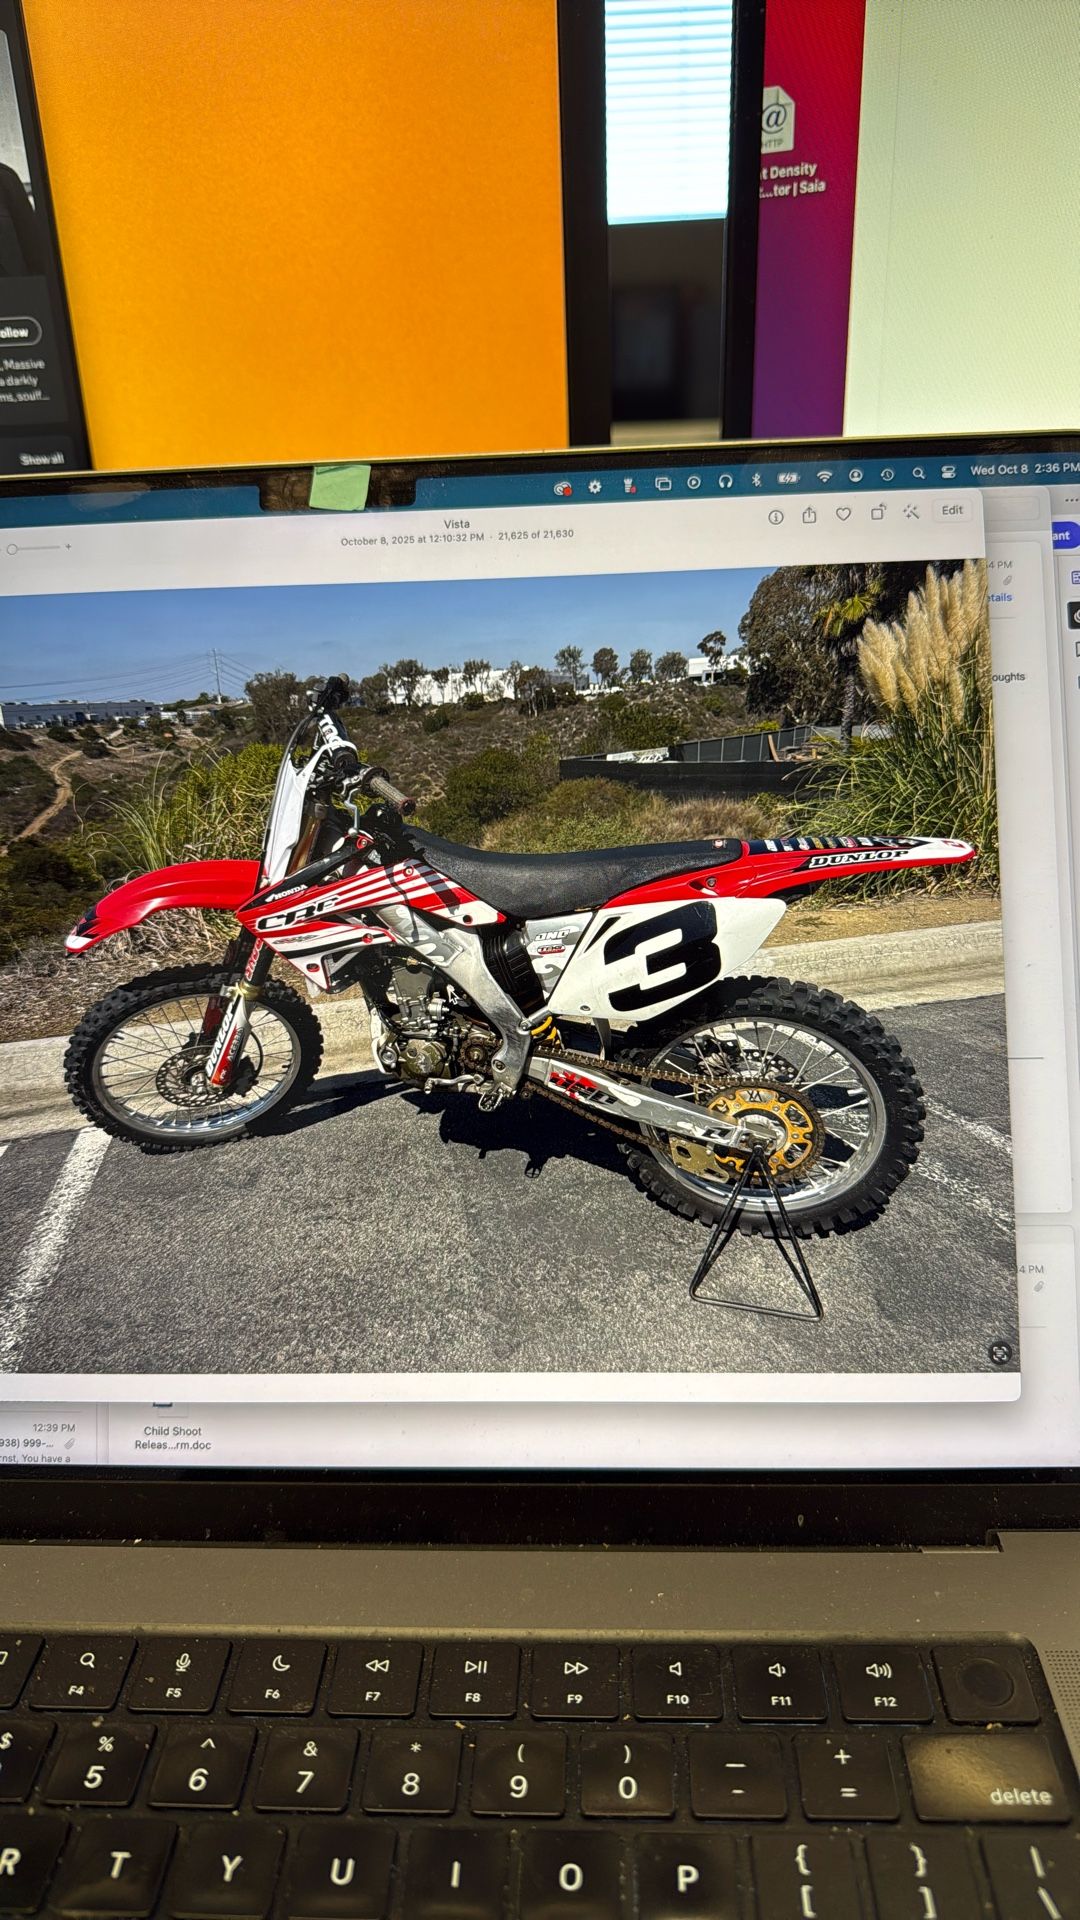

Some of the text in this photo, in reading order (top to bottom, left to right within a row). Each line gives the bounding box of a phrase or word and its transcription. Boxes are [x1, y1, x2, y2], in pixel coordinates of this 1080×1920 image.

[770, 162, 817, 179] Density
[799, 181, 826, 193] Saia
[3, 359, 45, 370] Massive
[6, 375, 38, 388] darkly
[19, 452, 64, 466] Show all
[970, 462, 1080, 476] Wed Oct 8 2:36 PM
[941, 505, 964, 516] Edit
[444, 519, 471, 529] Vista
[340, 529, 575, 547] October 8, 2025 at 12:10:32 PM 21,625 of 21,630
[997, 561, 1013, 569] PM
[992, 672, 1026, 684] oughts
[809, 850, 909, 868] DUNLOP
[273, 884, 309, 900] HONDA
[257, 896, 340, 931] CRF
[603, 901, 722, 1012] 3
[204, 1001, 234, 1079] DUNLOP
[1028, 1265, 1045, 1274] PM
[33, 1423, 76, 1433] 12:39 PM
[143, 1426, 202, 1436] Child Shoot
[135, 1440, 212, 1450] Releas...rm.doc
[21, 1455, 39, 1463] You
[41, 1454, 63, 1463] have
[68, 1685, 85, 1696] F4
[165, 1687, 182, 1698] F5
[264, 1688, 281, 1699] F6
[364, 1691, 381, 1702] F7
[464, 1692, 481, 1703] F8
[566, 1693, 583, 1704] F9
[666, 1694, 689, 1705] F10
[771, 1695, 792, 1706] F11
[874, 1696, 897, 1707] F12
[98, 1736, 115, 1752] %
[303, 1741, 318, 1757] &
[834, 1749, 851, 1765] +
[84, 1765, 104, 1789] 5
[188, 1767, 209, 1791] 6
[296, 1770, 314, 1793] 7
[401, 1772, 420, 1796] 8
[509, 1774, 528, 1799] 9
[618, 1776, 638, 1800] 0
[840, 1787, 858, 1798] =
[990, 1788, 1053, 1804] delete
[0, 1848, 21, 1875] R
[111, 1851, 131, 1878] T
[222, 1855, 242, 1882] Y
[330, 1858, 355, 1886] U
[559, 1863, 583, 1891] O
[677, 1864, 699, 1892] P
